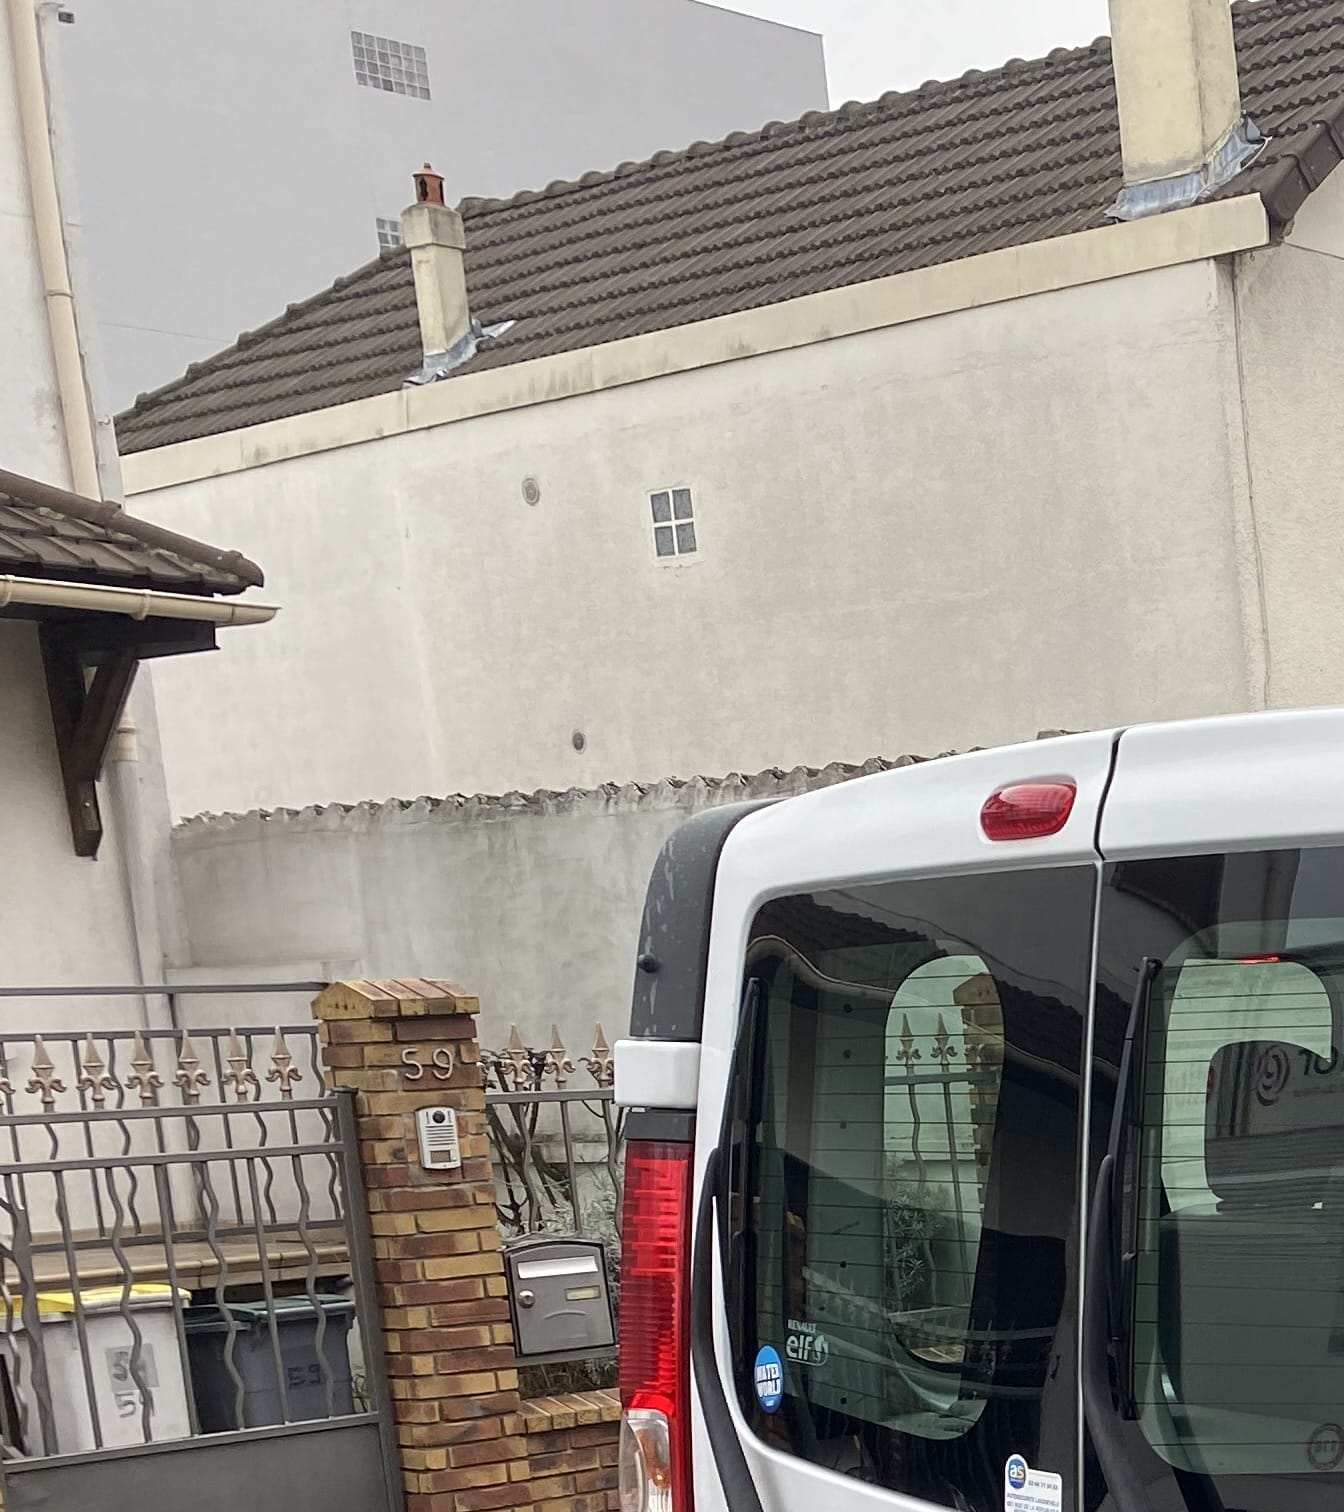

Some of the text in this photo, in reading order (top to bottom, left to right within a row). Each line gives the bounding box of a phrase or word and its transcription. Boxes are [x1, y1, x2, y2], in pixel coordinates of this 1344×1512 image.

[401, 1047, 454, 1080] 59
[785, 1335, 814, 1361] elf
[1010, 1464, 1025, 1480] as
